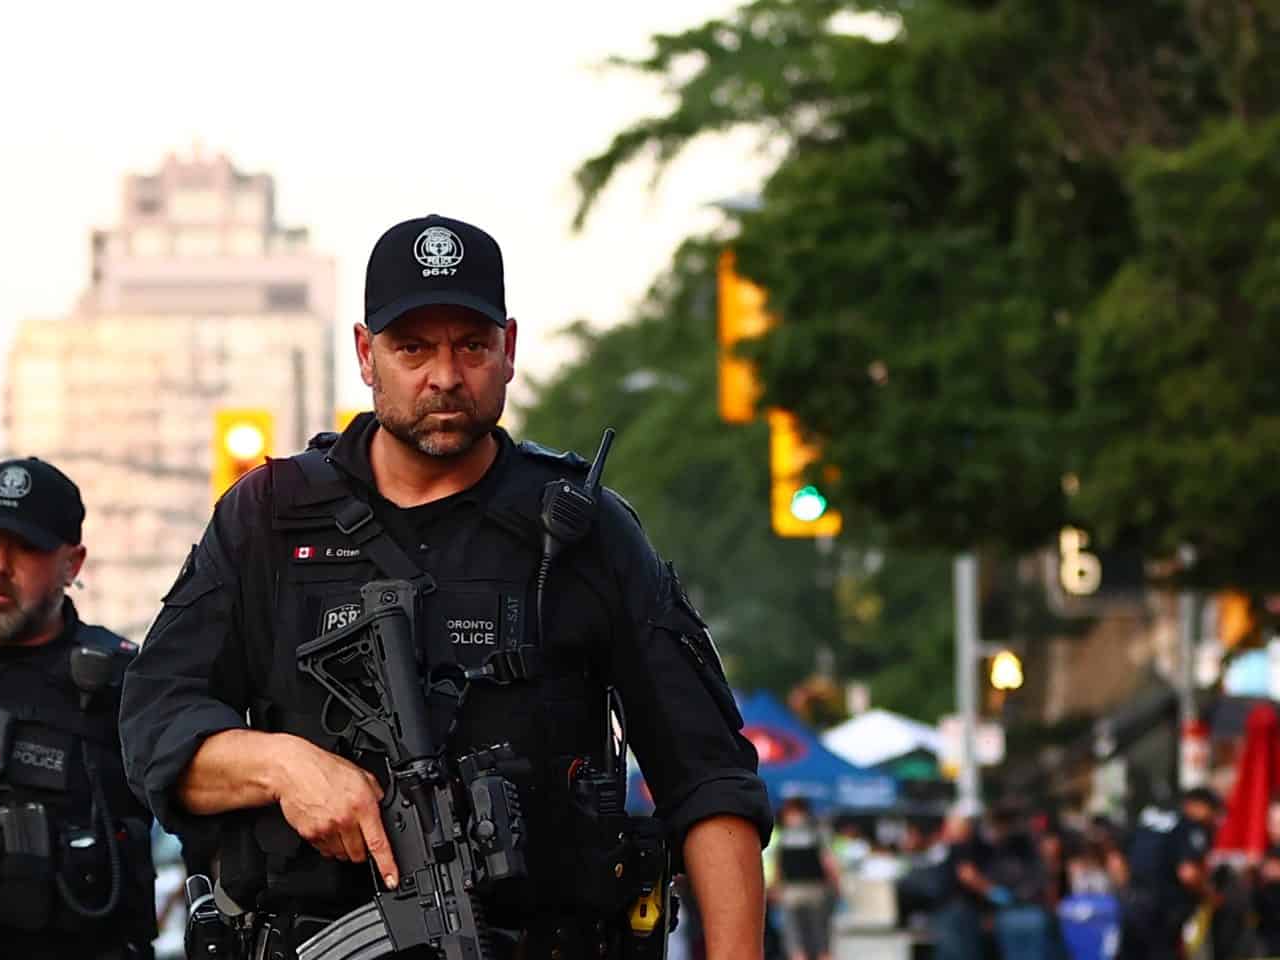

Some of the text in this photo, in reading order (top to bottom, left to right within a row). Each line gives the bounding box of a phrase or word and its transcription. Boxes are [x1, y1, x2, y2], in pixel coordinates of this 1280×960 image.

[447, 619, 494, 630] ORONTO
[450, 632, 495, 645] OLICE
[13, 750, 64, 772] POLICE
